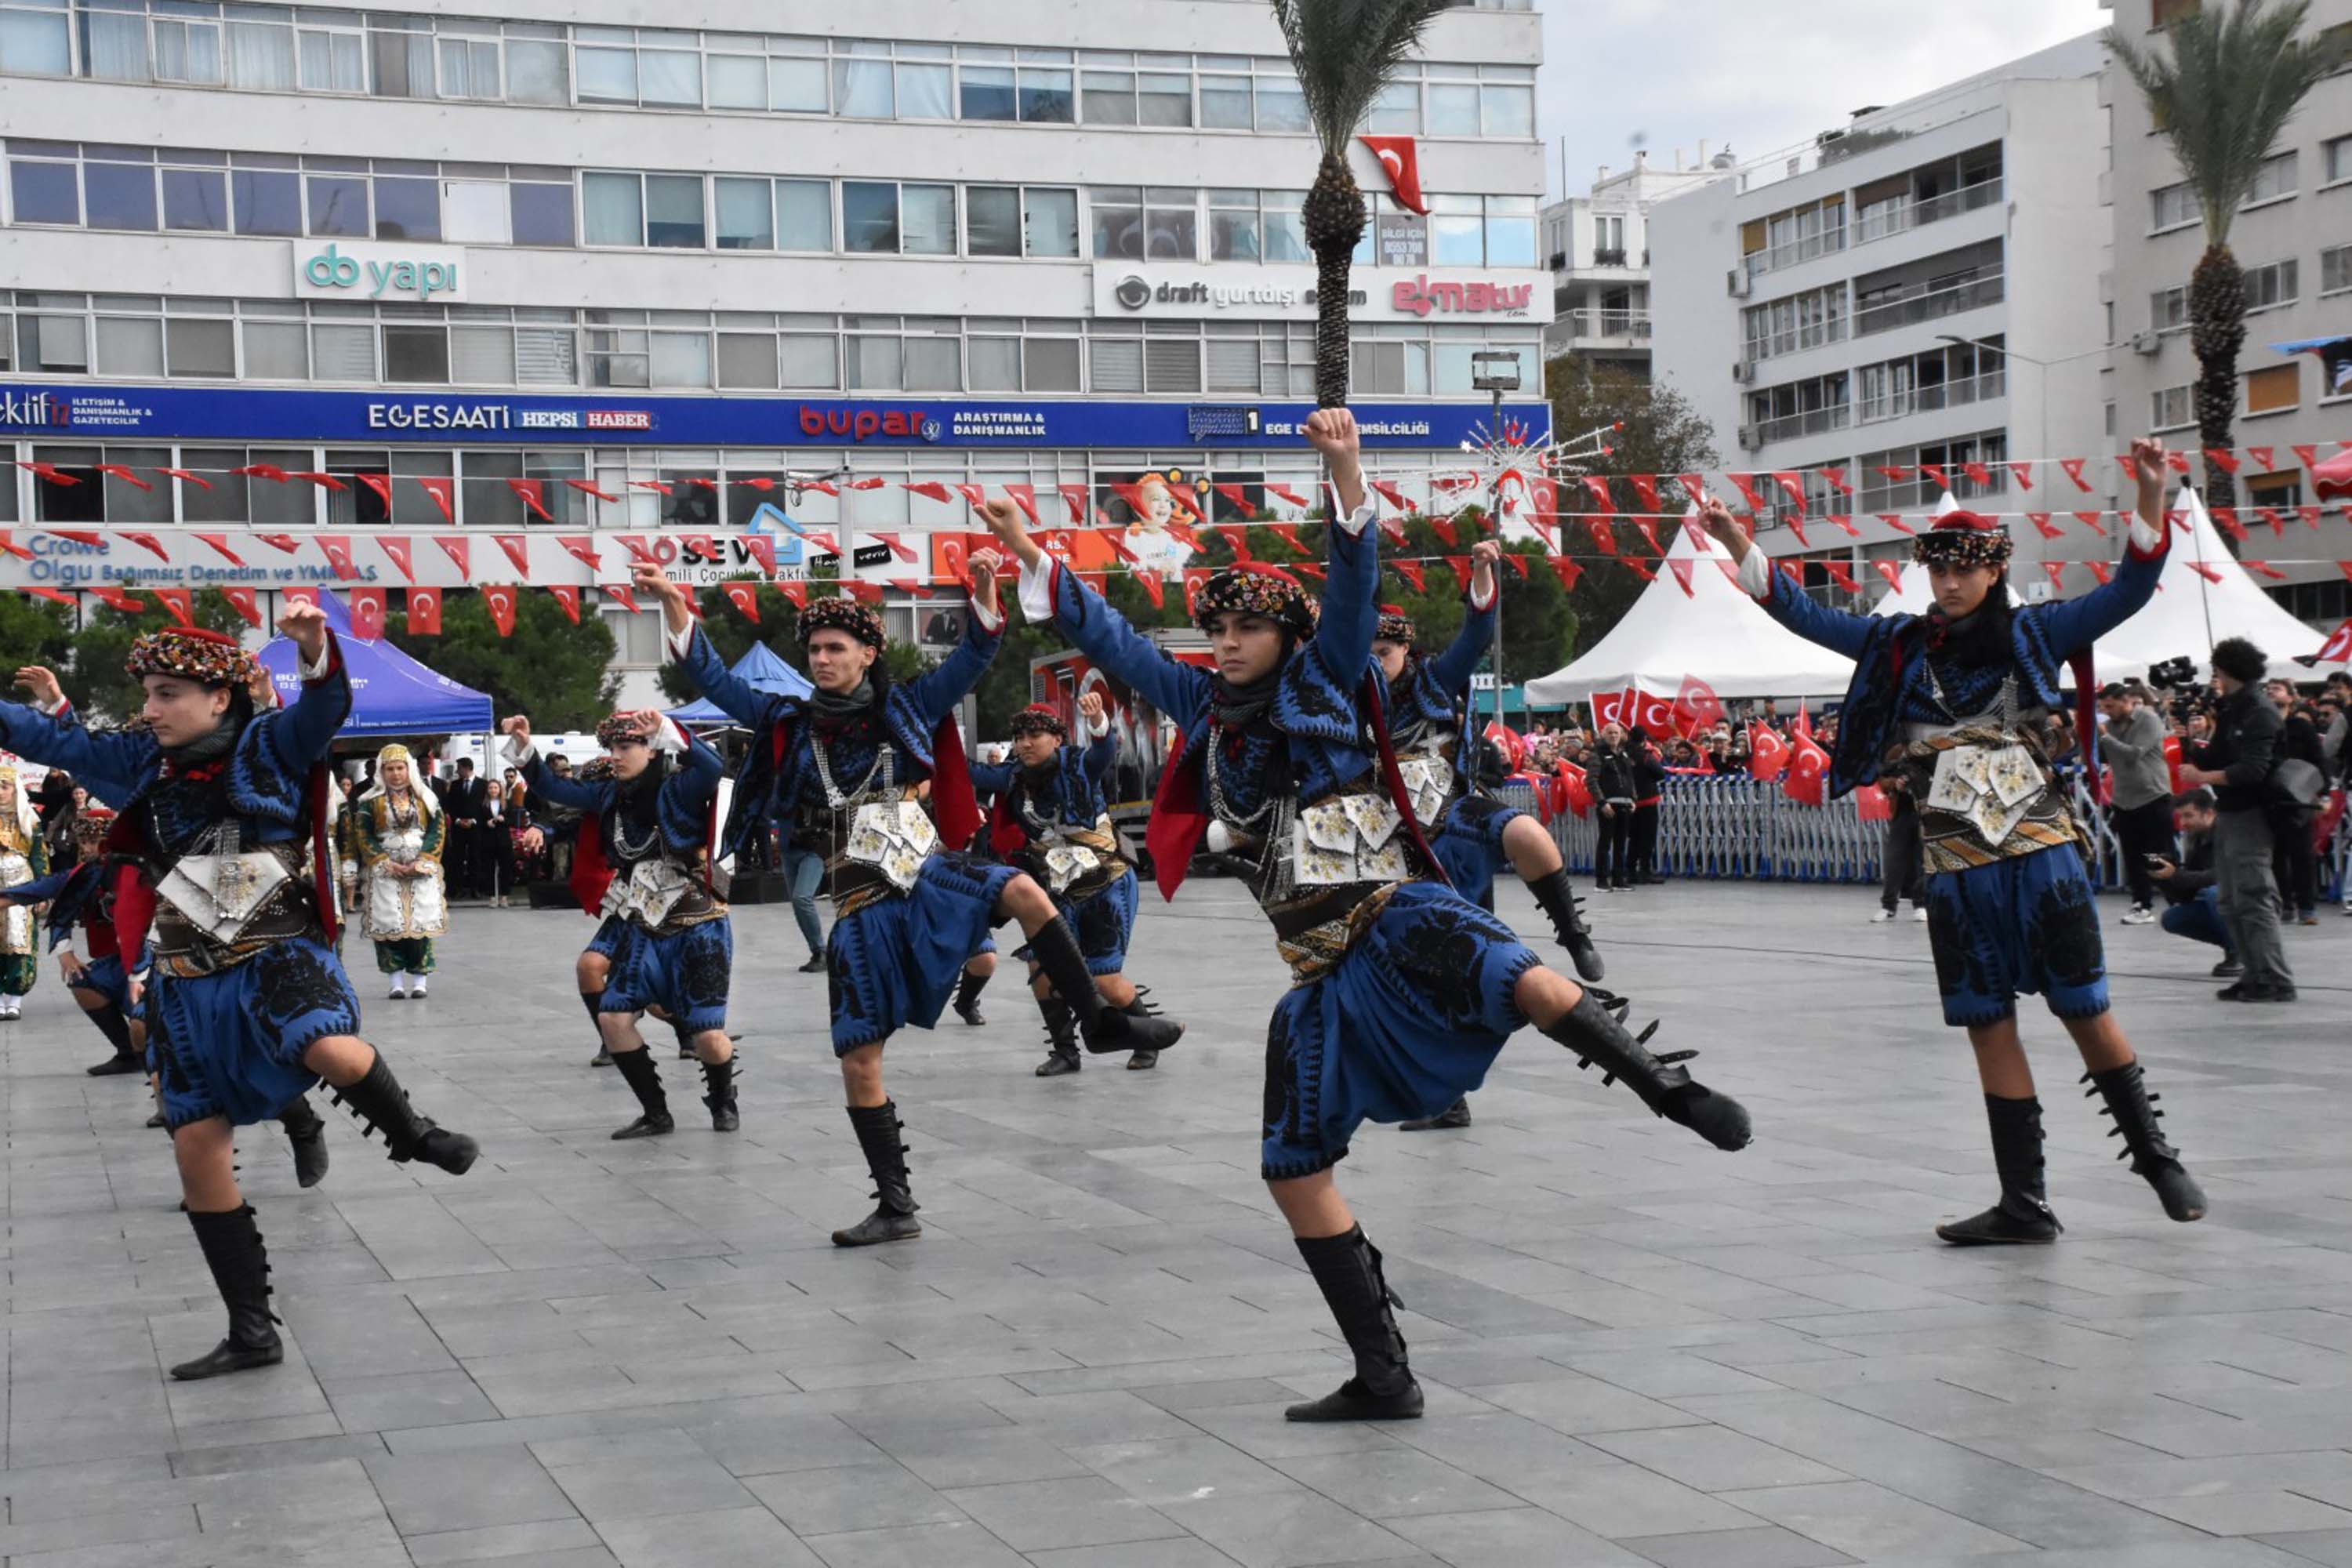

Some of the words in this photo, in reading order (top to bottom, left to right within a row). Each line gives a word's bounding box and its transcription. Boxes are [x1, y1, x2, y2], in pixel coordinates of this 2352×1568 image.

[368, 260, 457, 301] yapı
[1156, 281, 1209, 305] draft
[1215, 282, 1298, 309] yurtdışı
[1392, 274, 1533, 318] elmatur
[72, 397, 115, 406] İLETİŞİM
[118, 398, 125, 407] &
[73, 406, 142, 416] DANIŞMANLIK
[953, 412, 1033, 424] ARAŞTIRMA
[1035, 413, 1045, 423] &
[73, 415, 140, 426] GAZETECİLİK
[589, 412, 649, 427] HABER
[799, 405, 927, 441] bupar
[1248, 412, 1258, 430] 1
[953, 424, 1047, 437] DANIŞMANLIK
[1265, 423, 1292, 435] EGE
[1357, 420, 1430, 435] EMSİLCİLİĞİ
[630, 535, 757, 564] ÖSEV
[858, 550, 887, 561] verir
[29, 559, 93, 586] Olgu
[191, 564, 267, 581] Denetim
[273, 568, 294, 581] ve
